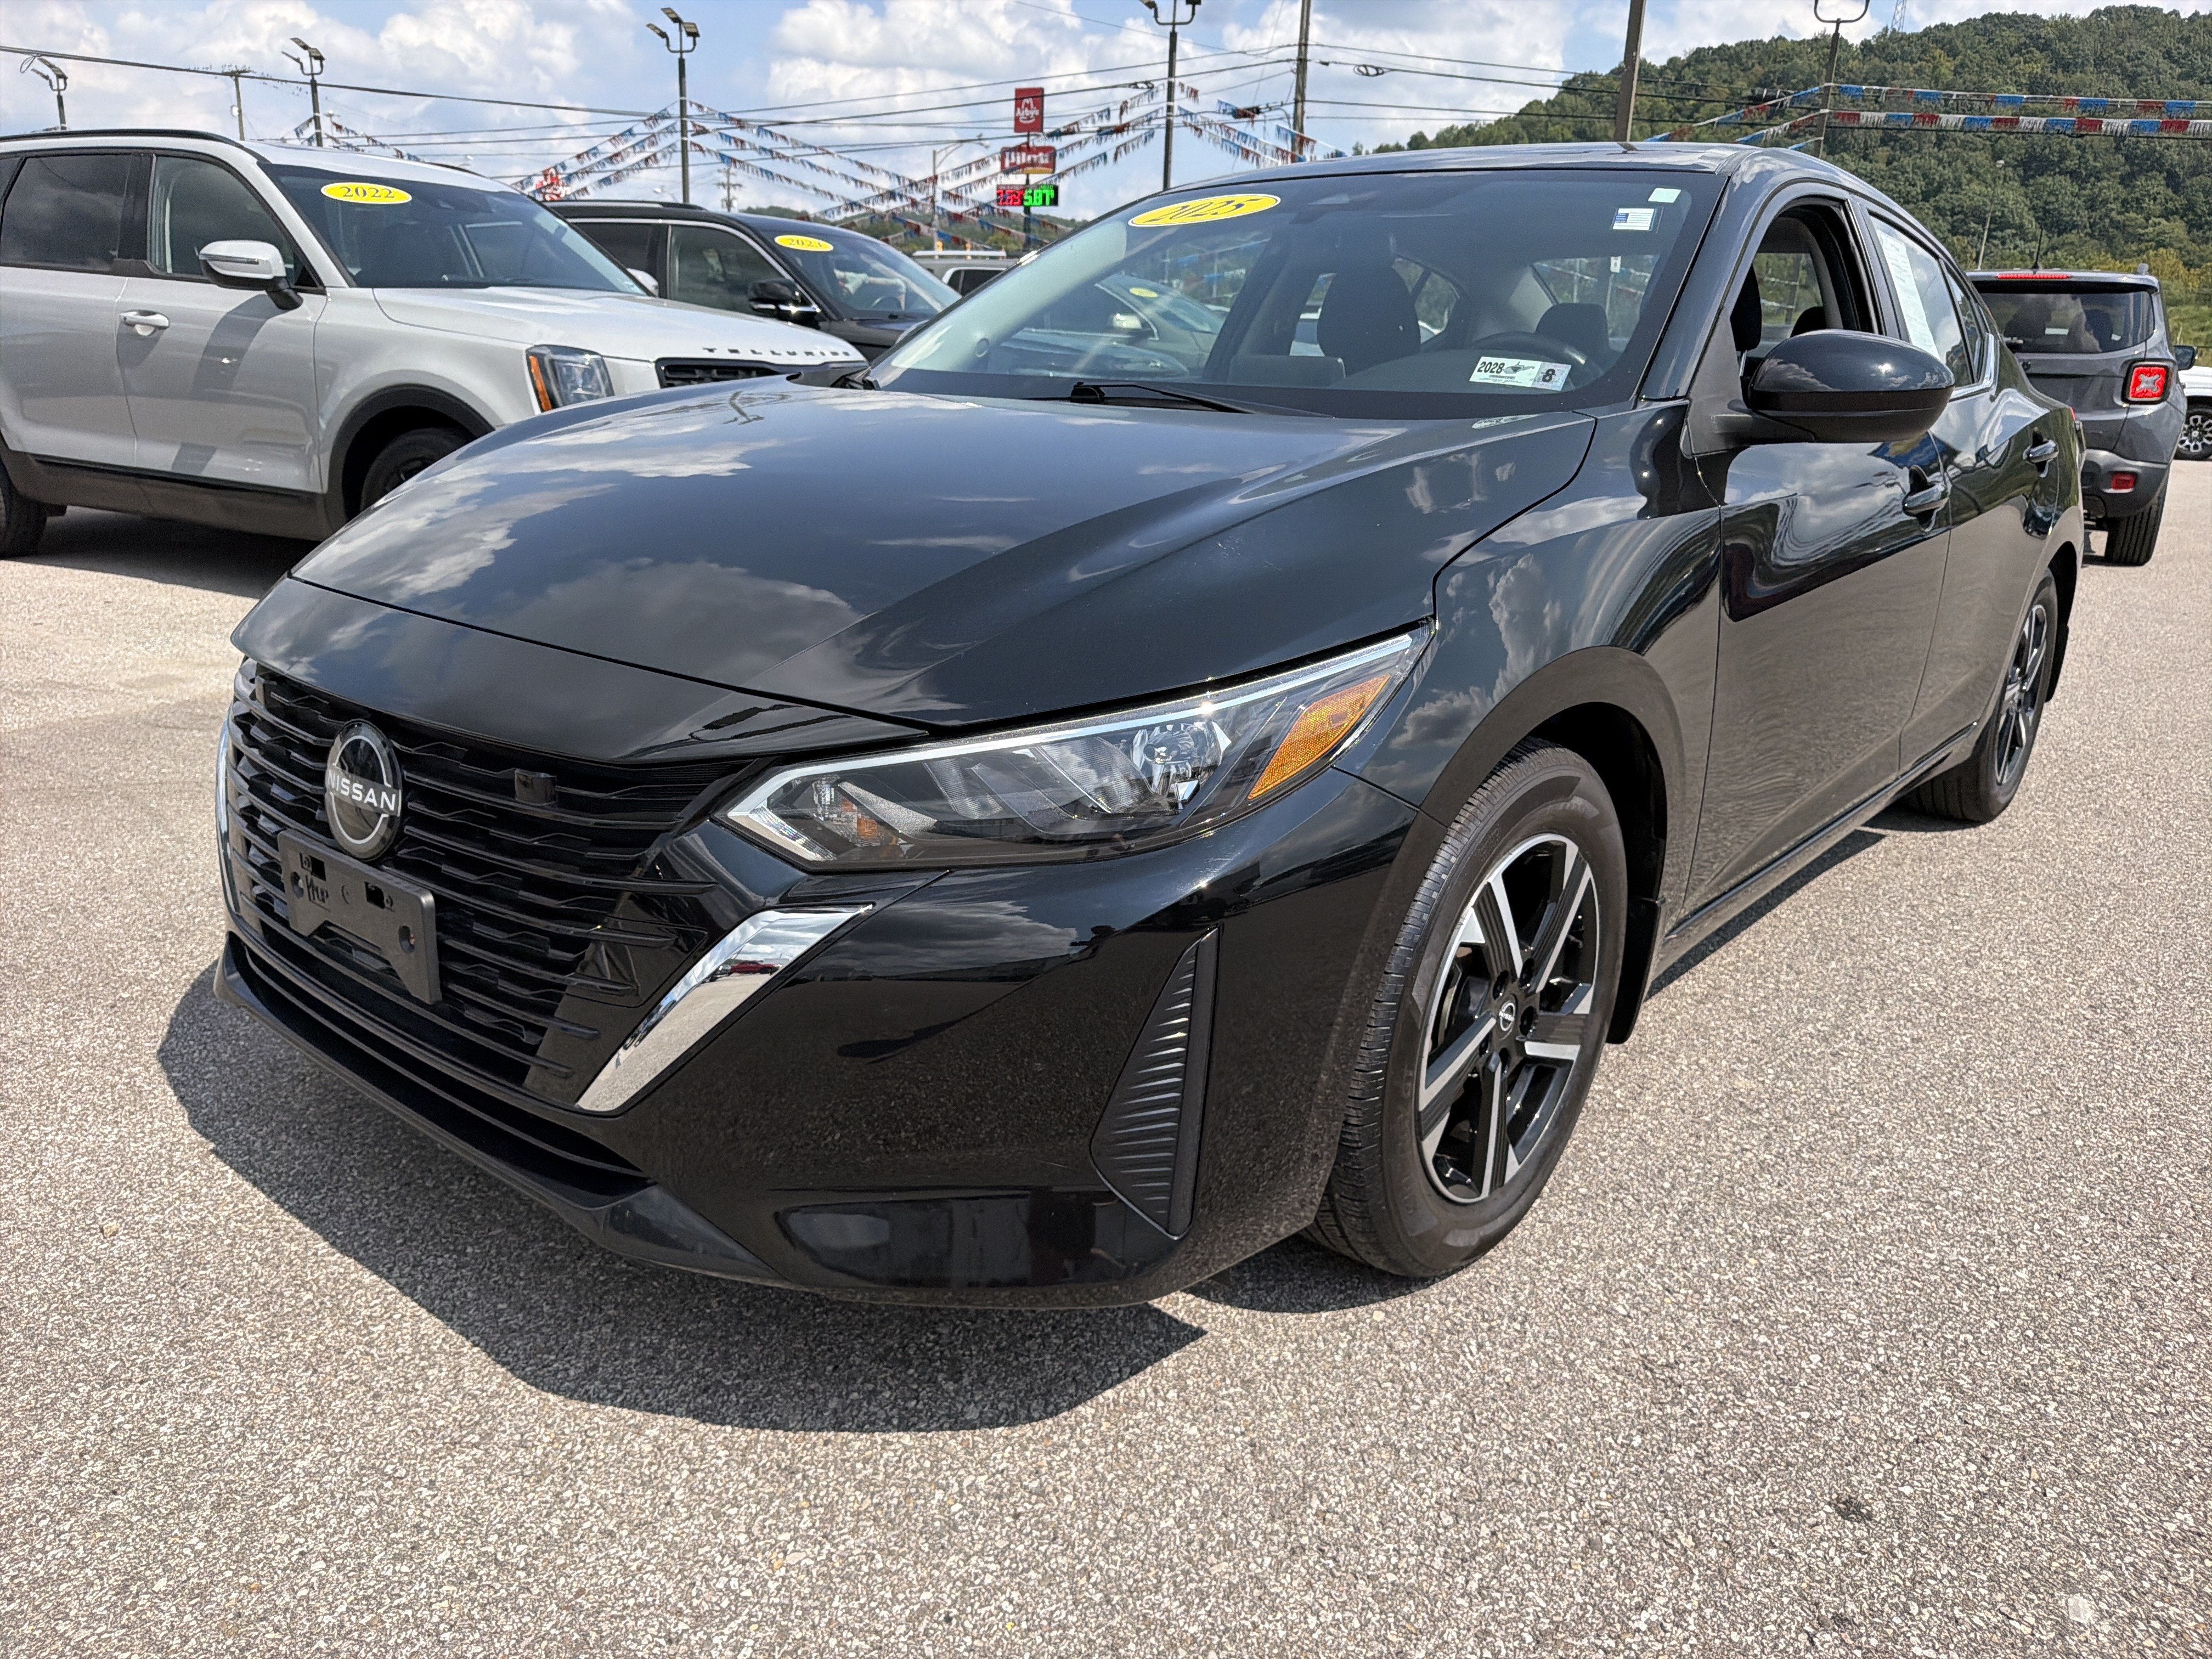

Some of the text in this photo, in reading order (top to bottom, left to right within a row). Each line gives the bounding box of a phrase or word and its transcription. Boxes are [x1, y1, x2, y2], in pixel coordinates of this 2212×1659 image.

[340, 186, 395, 199] 2022
[1142, 198, 1264, 223] 2025
[1477, 361, 1505, 374] 2028
[1542, 368, 1556, 383] 8
[328, 769, 396, 811] NISSAN
